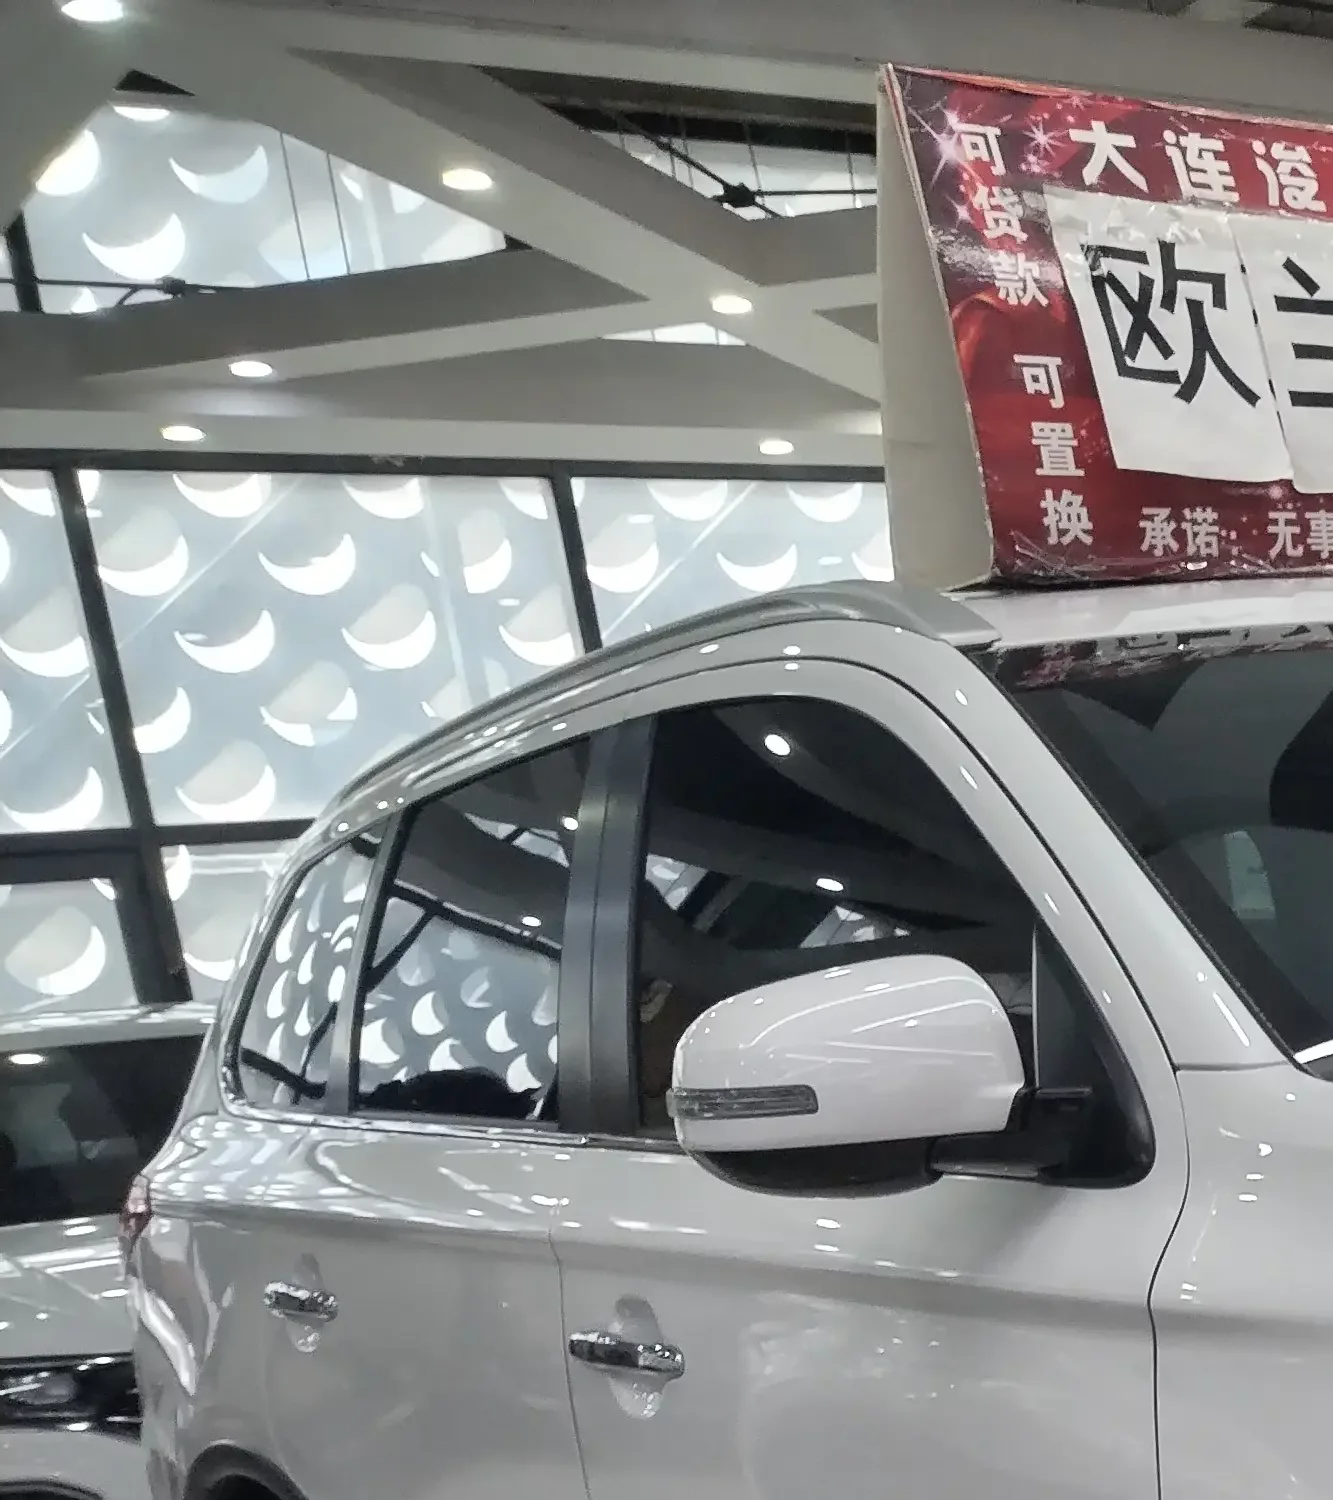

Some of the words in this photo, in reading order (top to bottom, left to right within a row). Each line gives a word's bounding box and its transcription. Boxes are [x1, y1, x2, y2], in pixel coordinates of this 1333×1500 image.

[961, 122, 1050, 308] 可贷款
[1012, 353, 1095, 546] 可置换
[1139, 506, 1221, 559] 承诺
